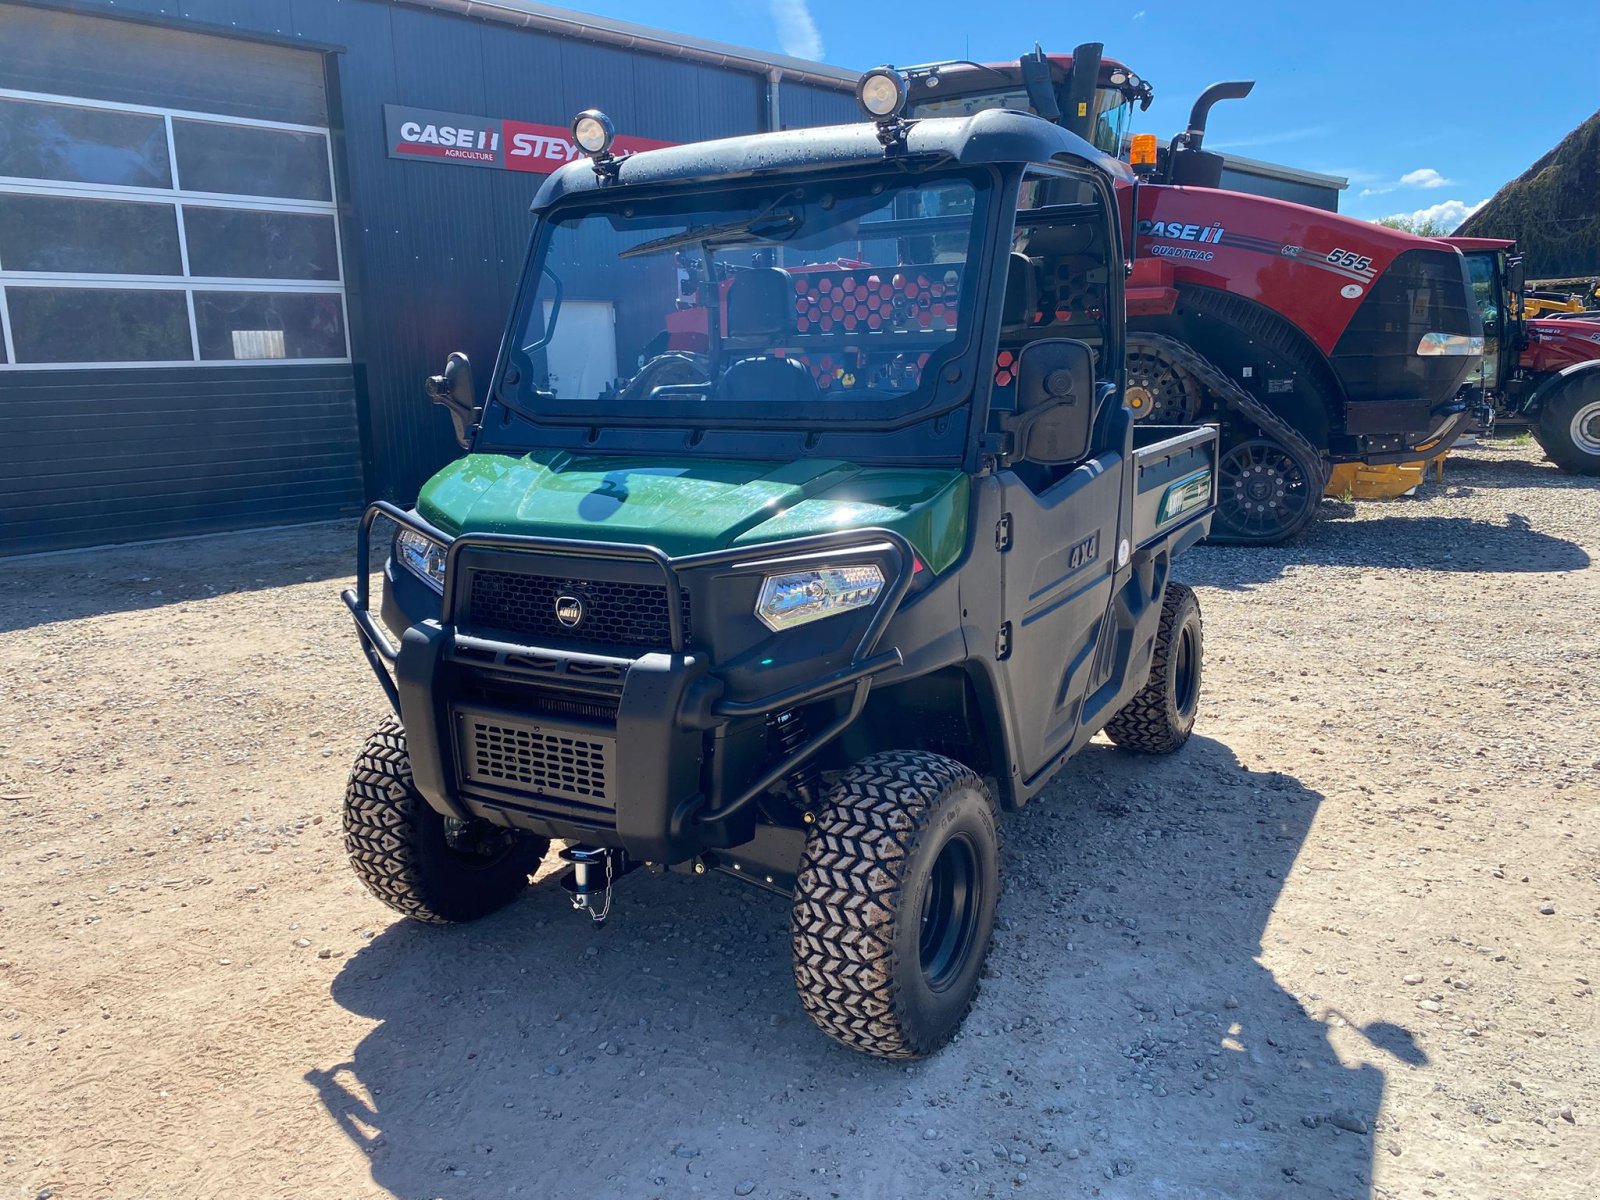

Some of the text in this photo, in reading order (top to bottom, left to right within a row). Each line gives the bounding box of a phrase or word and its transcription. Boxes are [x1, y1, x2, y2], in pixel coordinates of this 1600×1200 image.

[400, 121, 475, 148] CASE
[511, 133, 585, 161] STEY
[444, 149, 494, 161] AGRICULTURE
[1137, 220, 1199, 241] CASE
[1152, 245, 1214, 262] QUADTRAC
[1327, 247, 1373, 272] 555
[1069, 535, 1096, 569] 4X4
